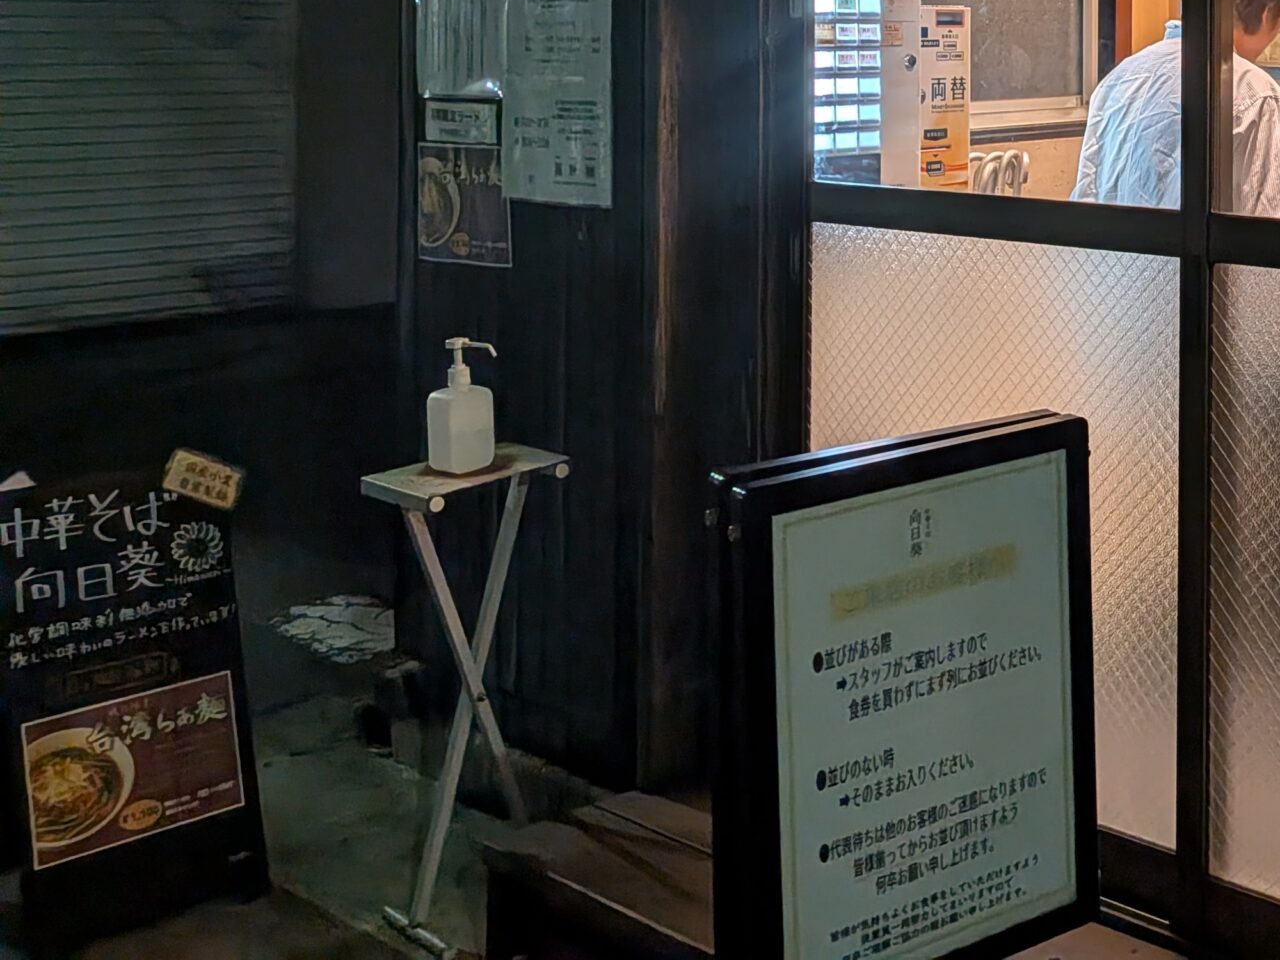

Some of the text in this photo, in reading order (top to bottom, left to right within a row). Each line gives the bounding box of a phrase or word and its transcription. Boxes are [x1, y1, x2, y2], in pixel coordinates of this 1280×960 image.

[931, 76, 966, 101] 両替
[0, 488, 178, 559] 中華そば
[15, 540, 166, 614] 向日葵
[824, 631, 893, 671] 並びがある際
[848, 632, 989, 692] スタッフがご案内しますので
[827, 747, 896, 789] 並びのない時
[850, 752, 976, 808] そのままお入りください。
[875, 837, 995, 896] 何卒お願い申し上げます。
